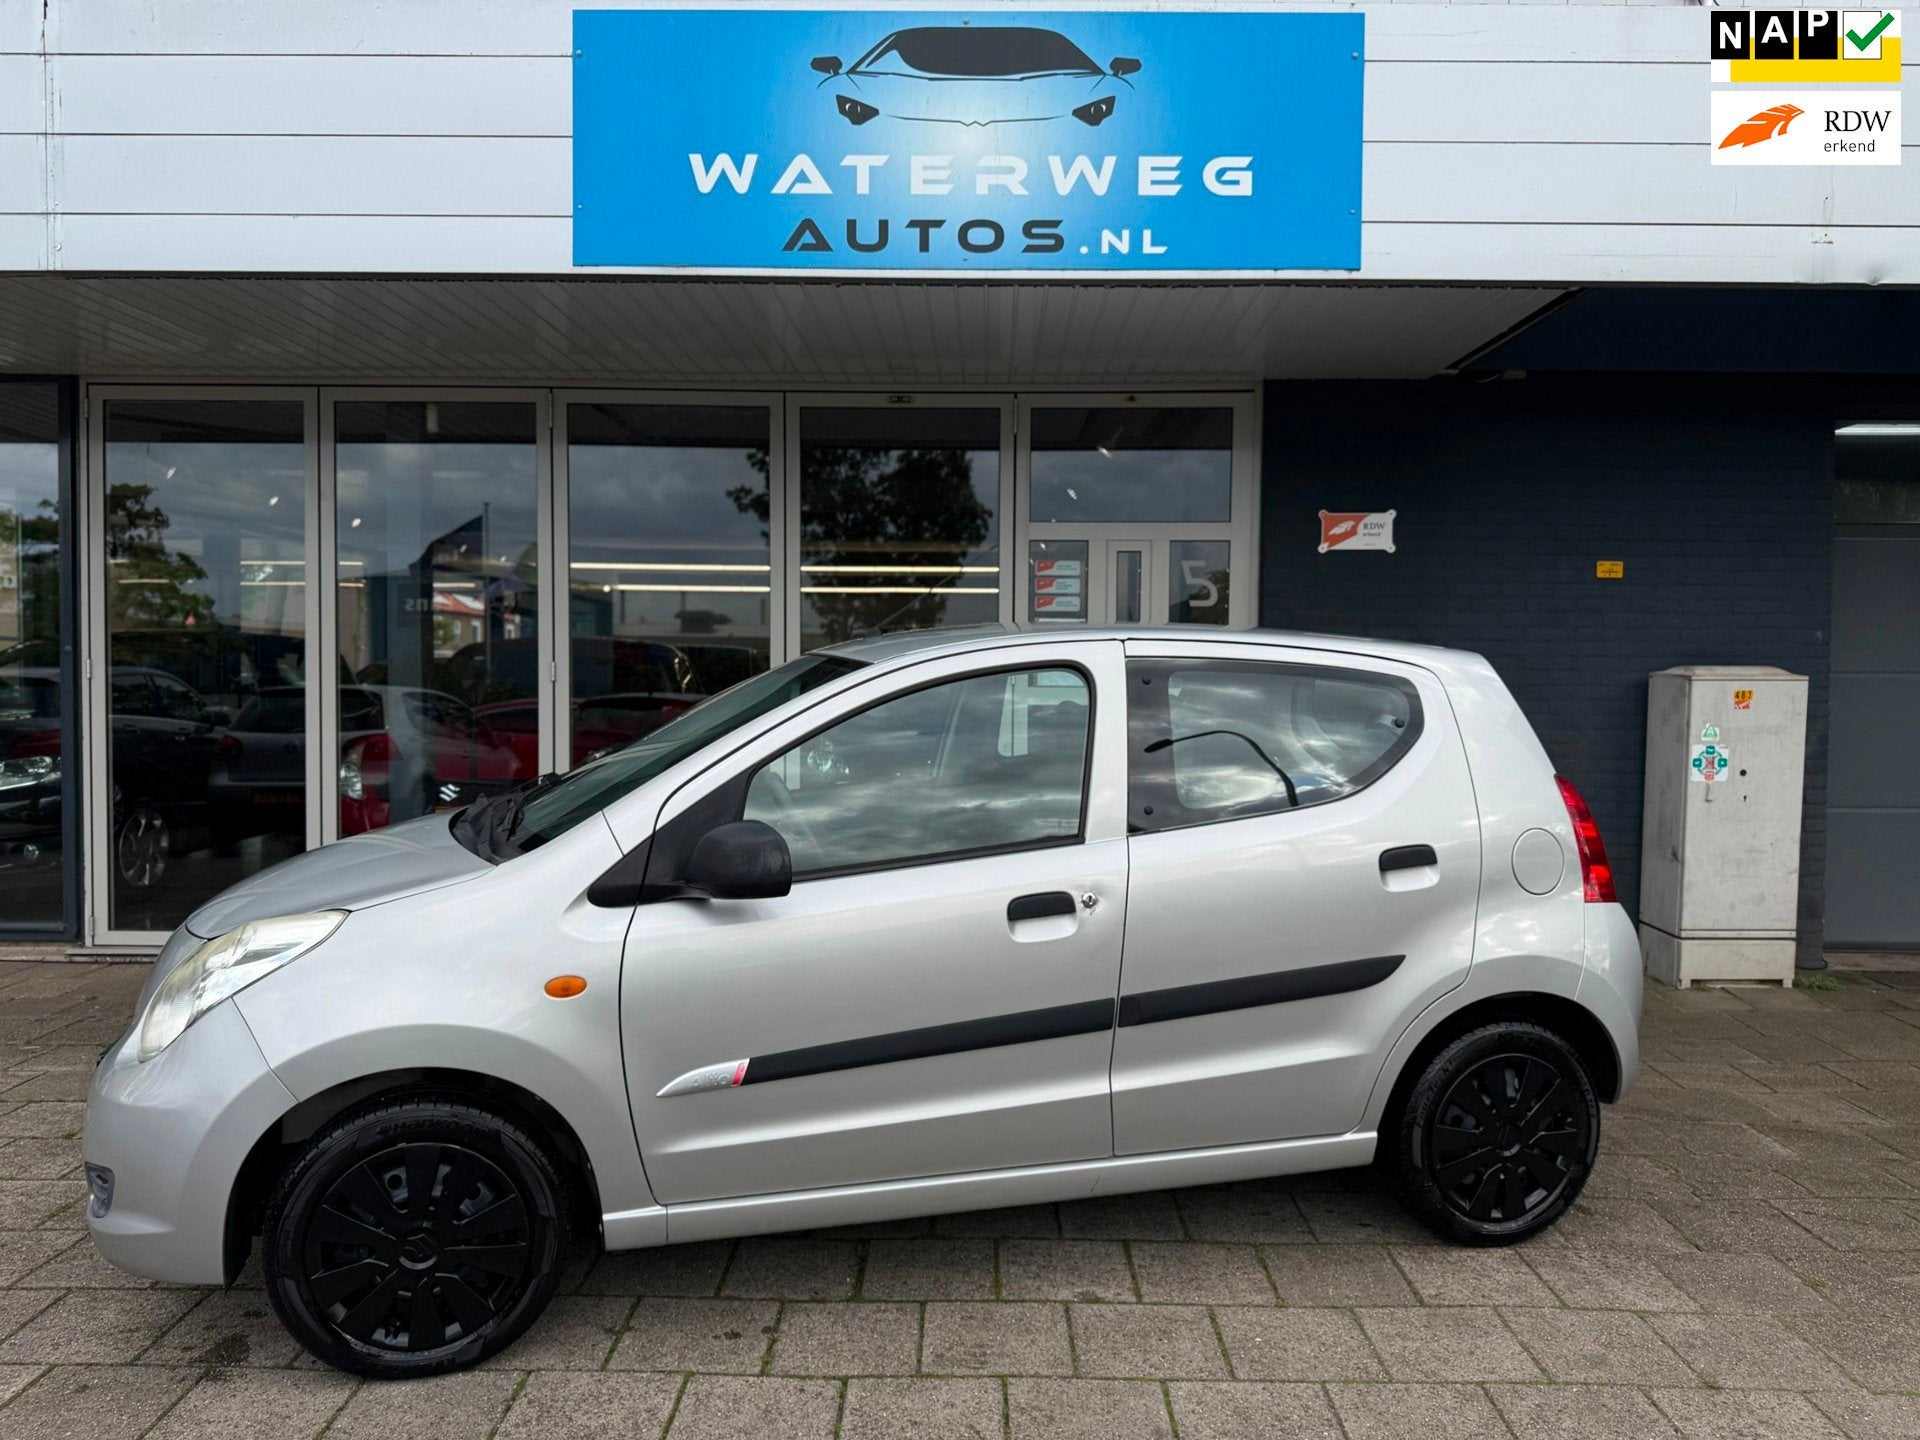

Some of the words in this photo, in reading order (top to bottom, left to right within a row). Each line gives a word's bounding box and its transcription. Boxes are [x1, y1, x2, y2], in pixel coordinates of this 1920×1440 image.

[688, 153, 1254, 197] WATERWEG
[780, 218, 1168, 255] AUTOS.NL
[1363, 522, 1386, 530] RDW
[1181, 560, 1218, 607] 5
